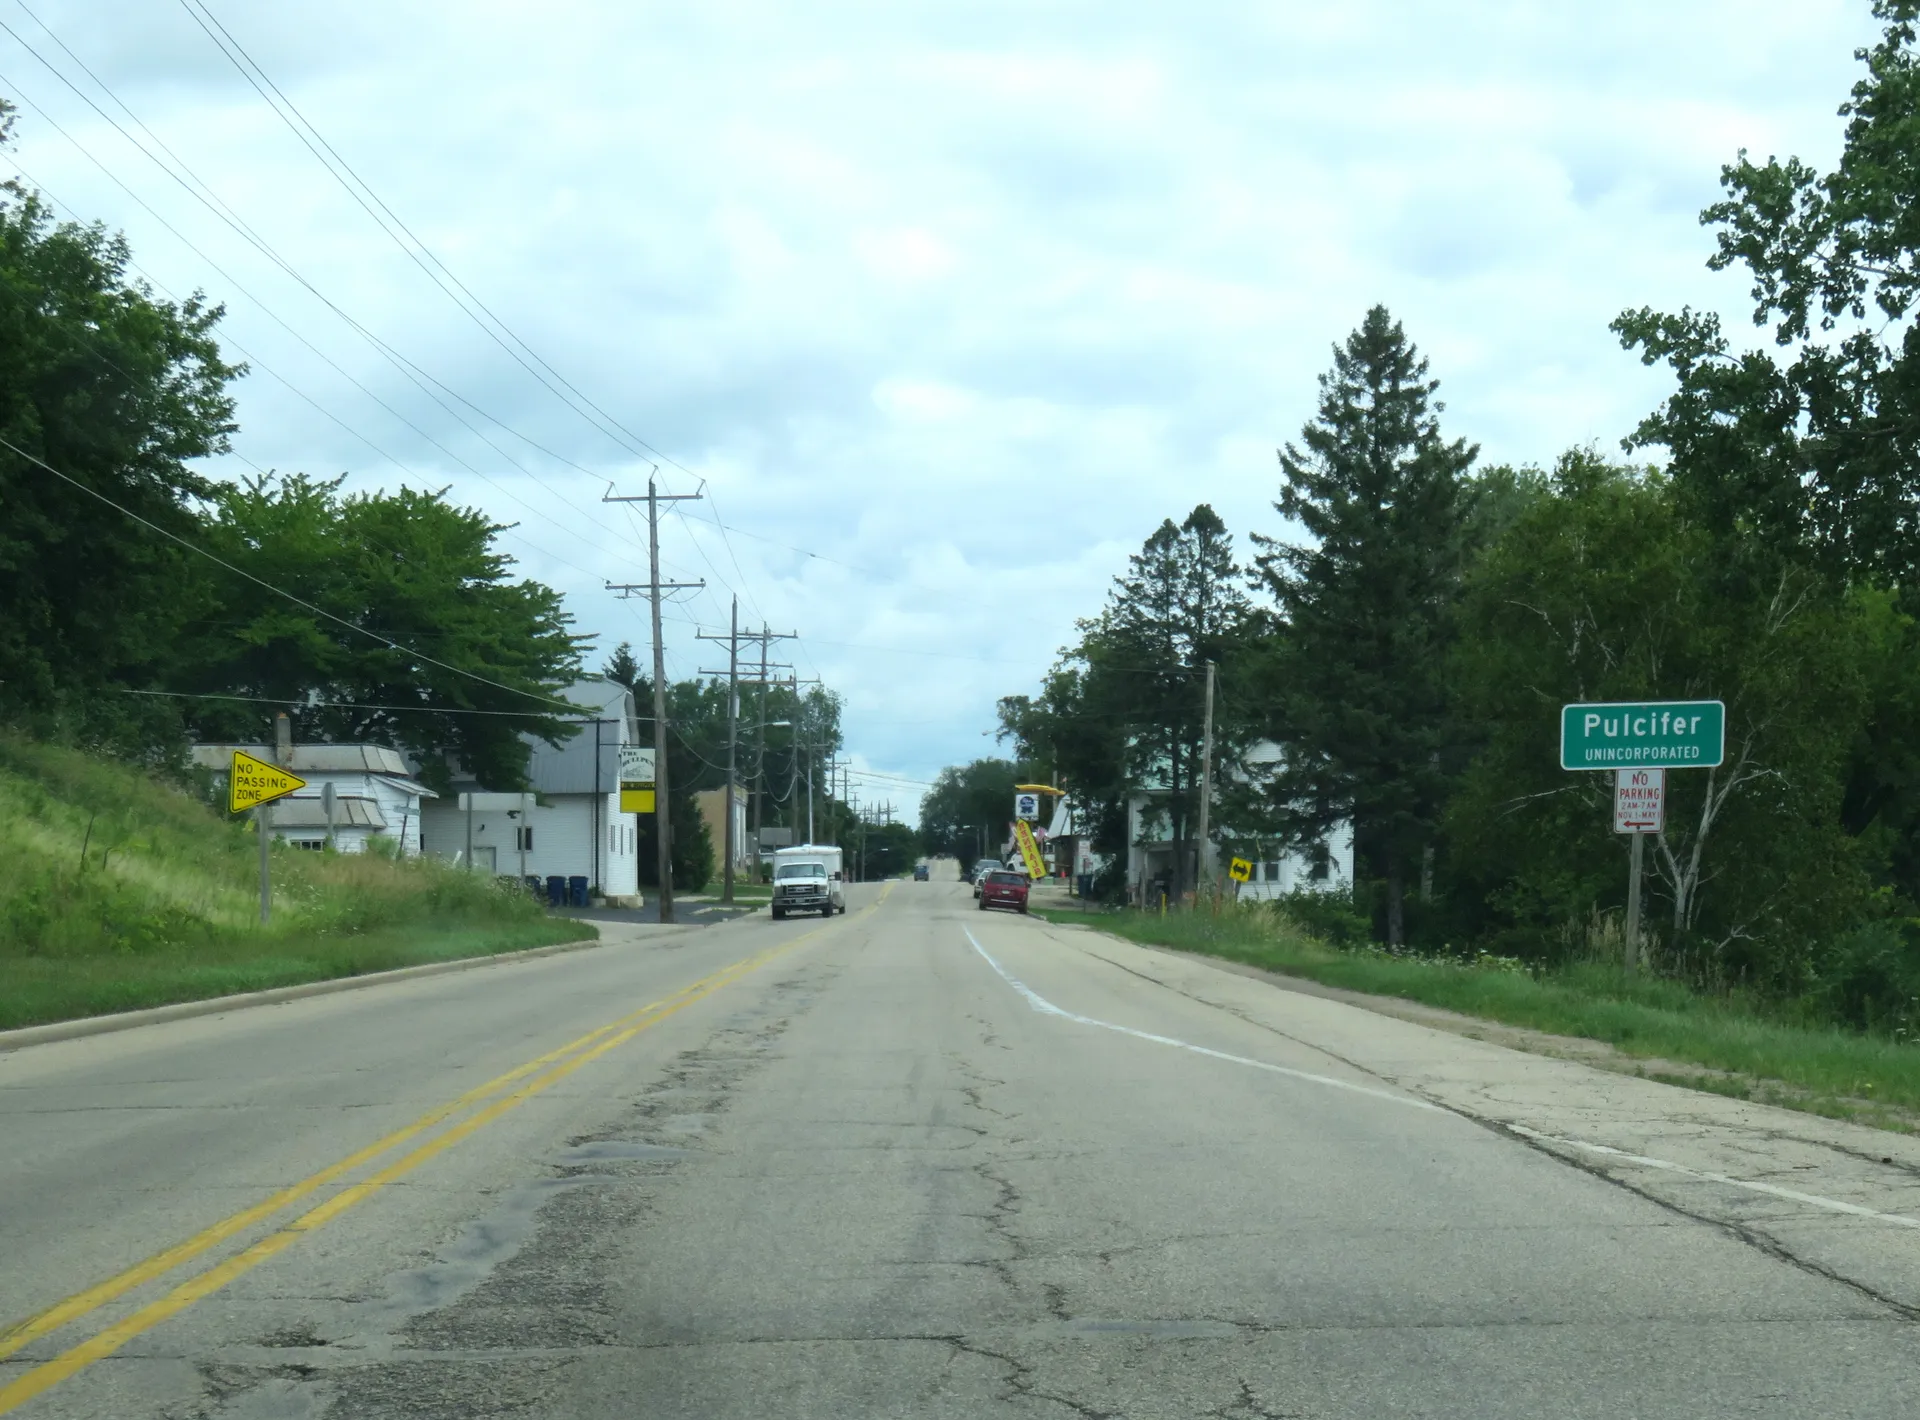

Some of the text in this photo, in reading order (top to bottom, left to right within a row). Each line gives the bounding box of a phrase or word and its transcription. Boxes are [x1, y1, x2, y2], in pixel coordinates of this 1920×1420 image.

[1584, 712, 1702, 737] Pulcifer
[1585, 746, 1700, 761] UNINCORPORATED
[237, 764, 253, 774] NO
[237, 776, 287, 789] PASSING
[1632, 773, 1649, 786] NO
[236, 789, 262, 801] ZONE
[1620, 788, 1660, 800] PARKING
[1018, 822, 1043, 877] RENTALS
